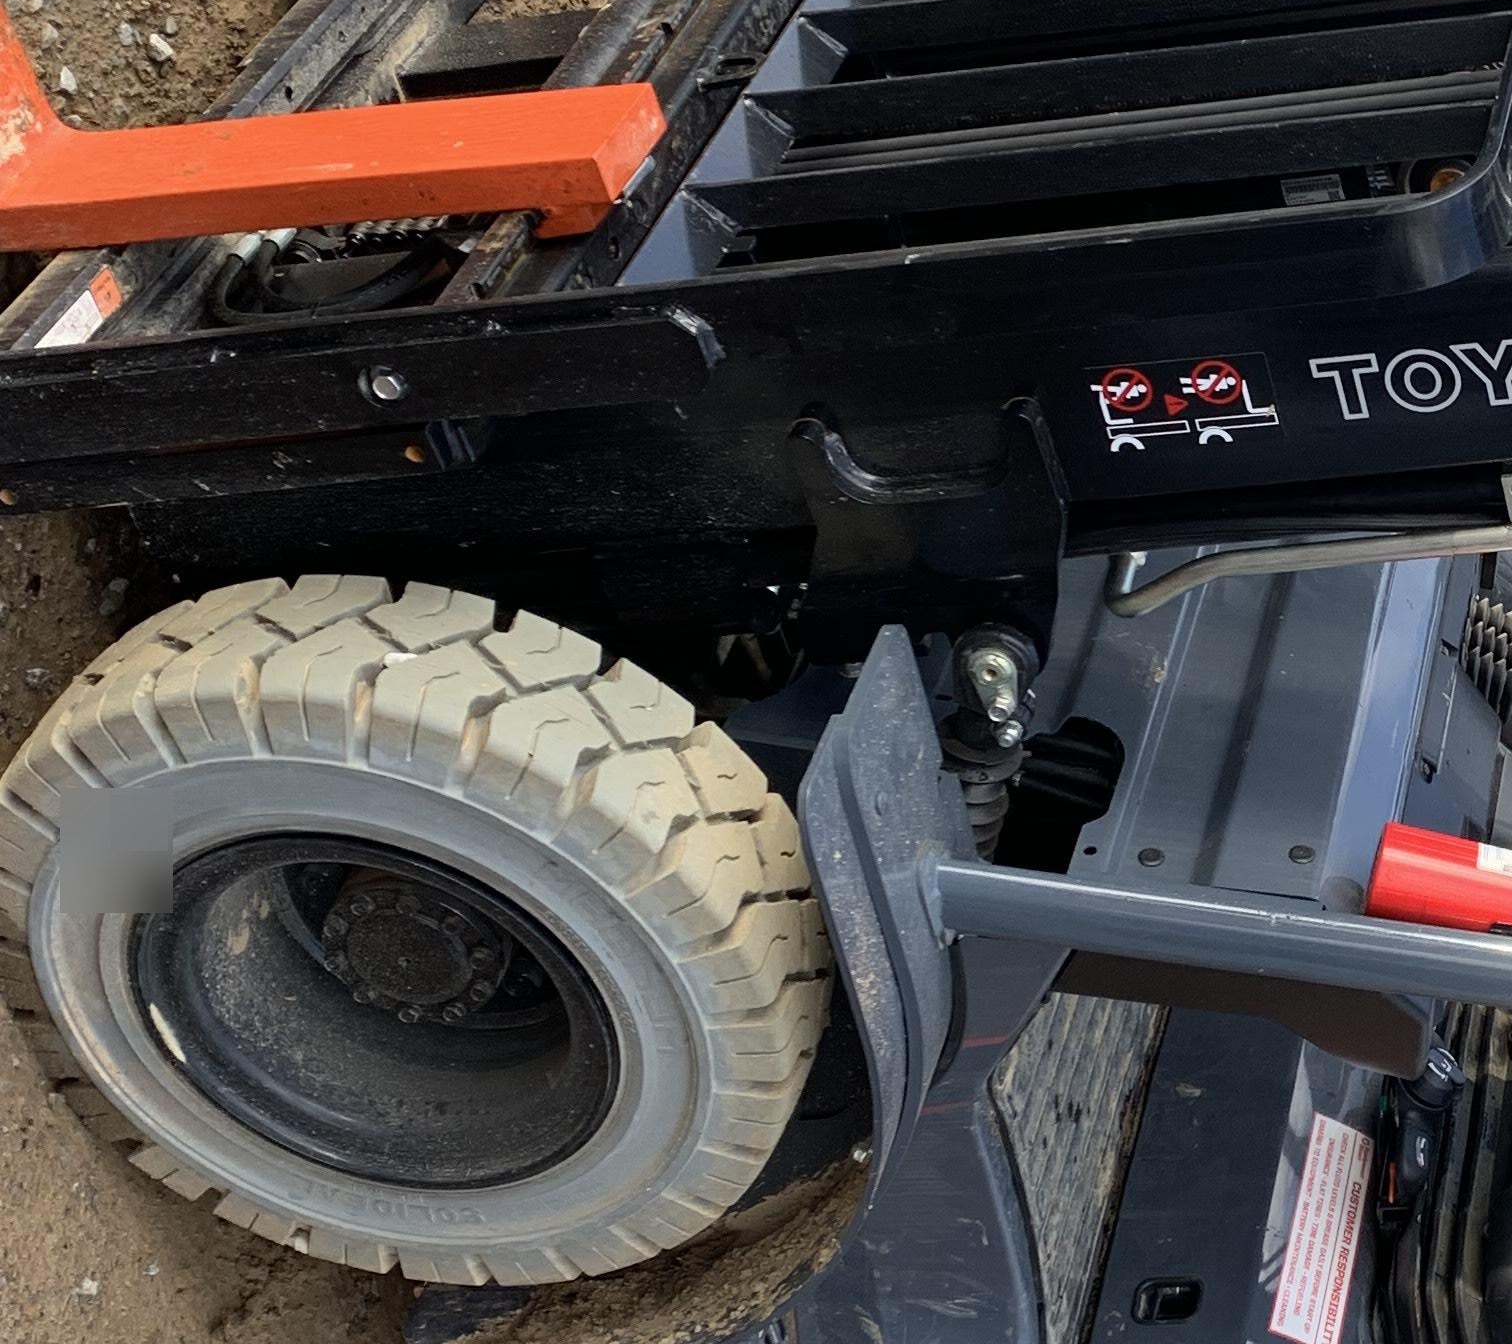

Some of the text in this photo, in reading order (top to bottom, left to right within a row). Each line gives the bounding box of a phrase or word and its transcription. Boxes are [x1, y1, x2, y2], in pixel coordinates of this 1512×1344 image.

[1337, 1154, 1345, 1166] ALL
[1328, 1188, 1339, 1211] LEVELS
[1343, 1181, 1362, 1245] CUSTOMER
[1318, 1247, 1327, 1268] DAILY
[1307, 1298, 1318, 1321] START
